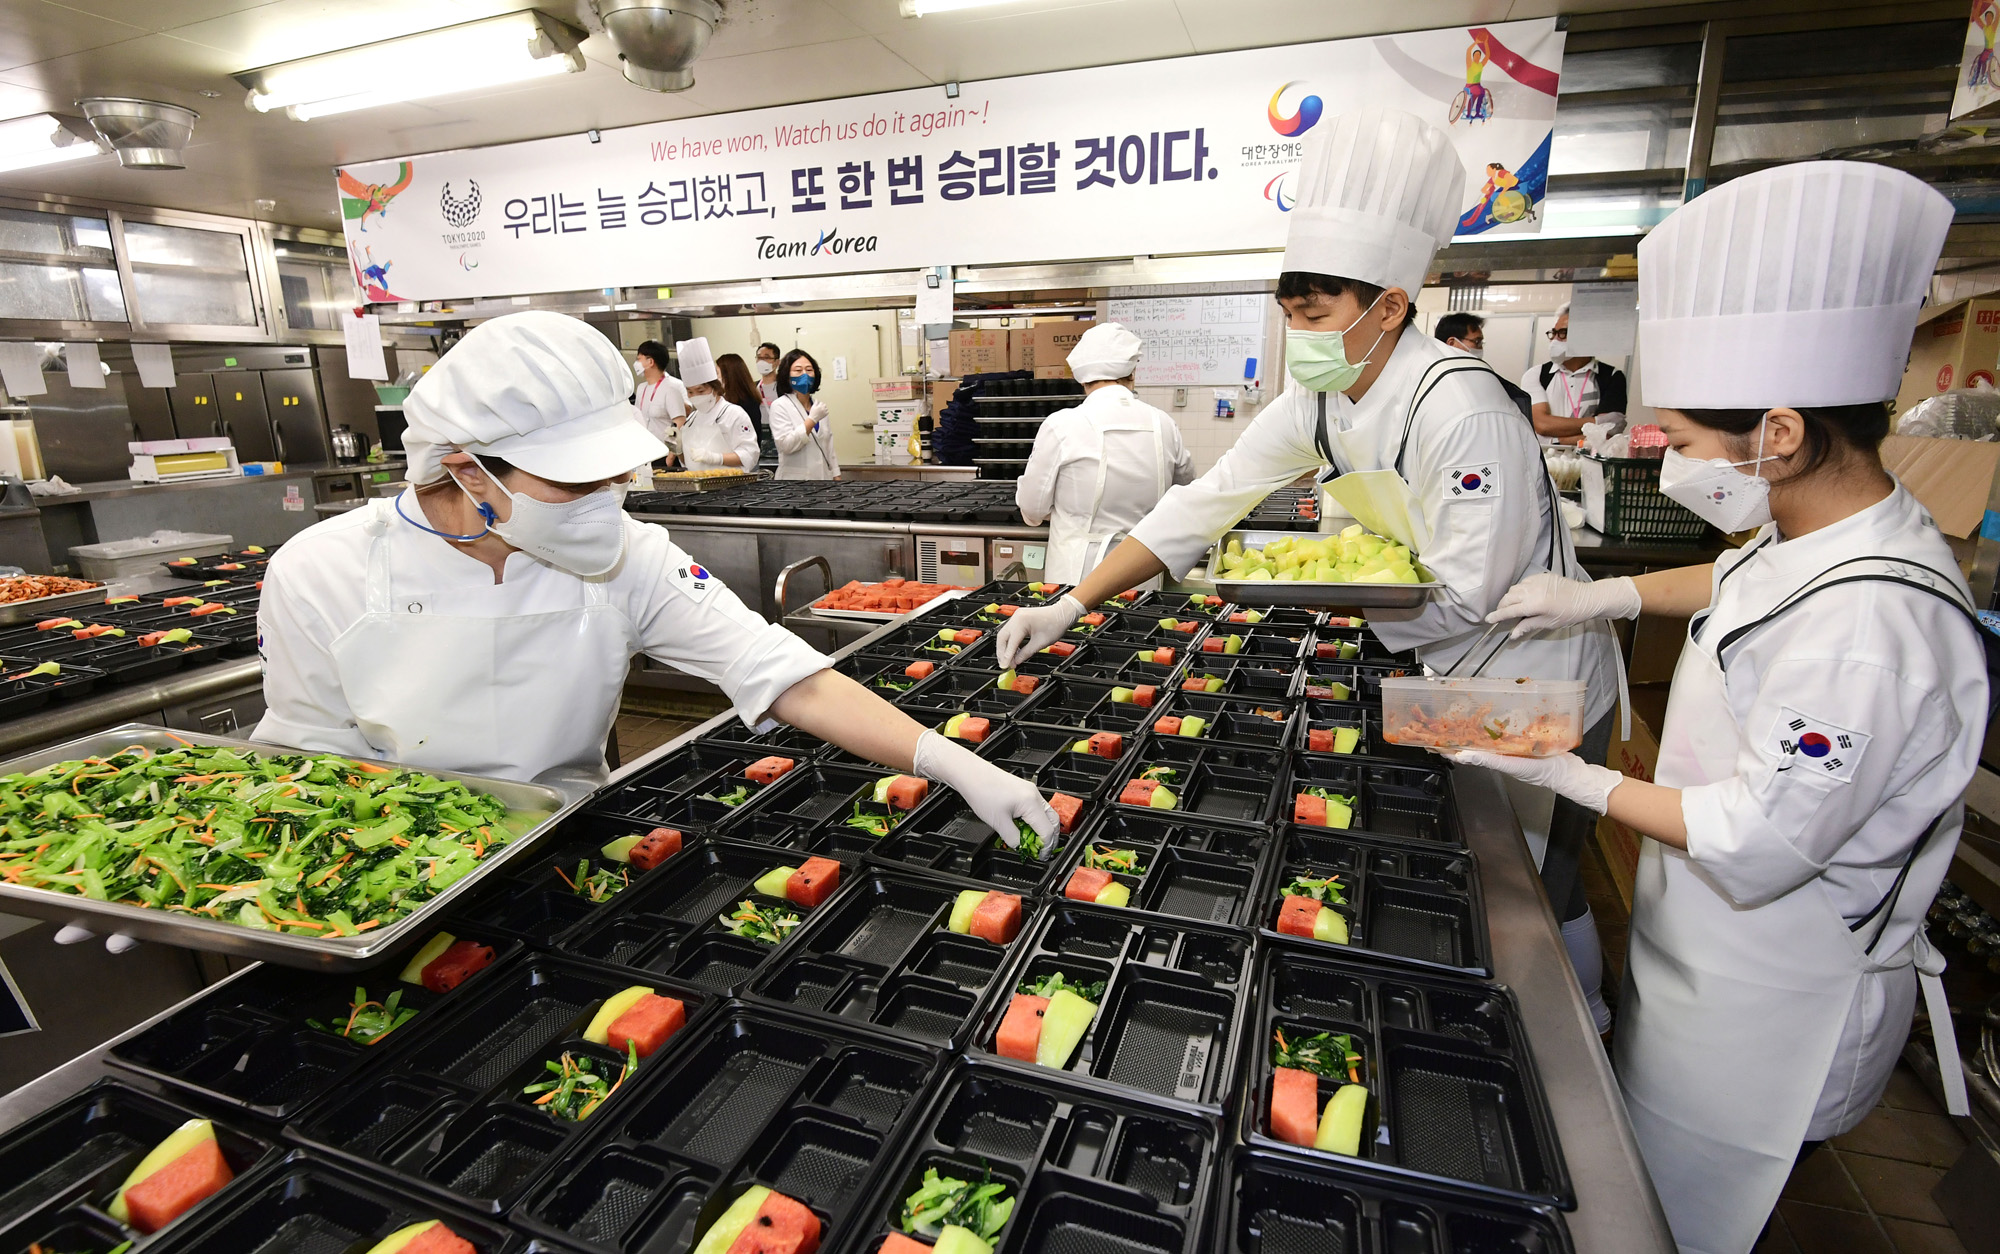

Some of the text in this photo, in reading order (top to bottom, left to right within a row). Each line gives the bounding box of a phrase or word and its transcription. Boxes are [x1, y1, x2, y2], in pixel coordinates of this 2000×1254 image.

[651, 140, 677, 162] We
[681, 136, 722, 160] have
[727, 132, 768, 153] won,
[774, 119, 831, 148] Watch
[836, 121, 858, 141] us
[862, 112, 887, 138] do
[892, 109, 906, 134] it
[503, 127, 1219, 239] 우리는 늘 승리했고, 또 한 번 승리할 것이다.
[442, 230, 486, 244] TOKYO 2020
[755, 227, 878, 260] Team Korea
